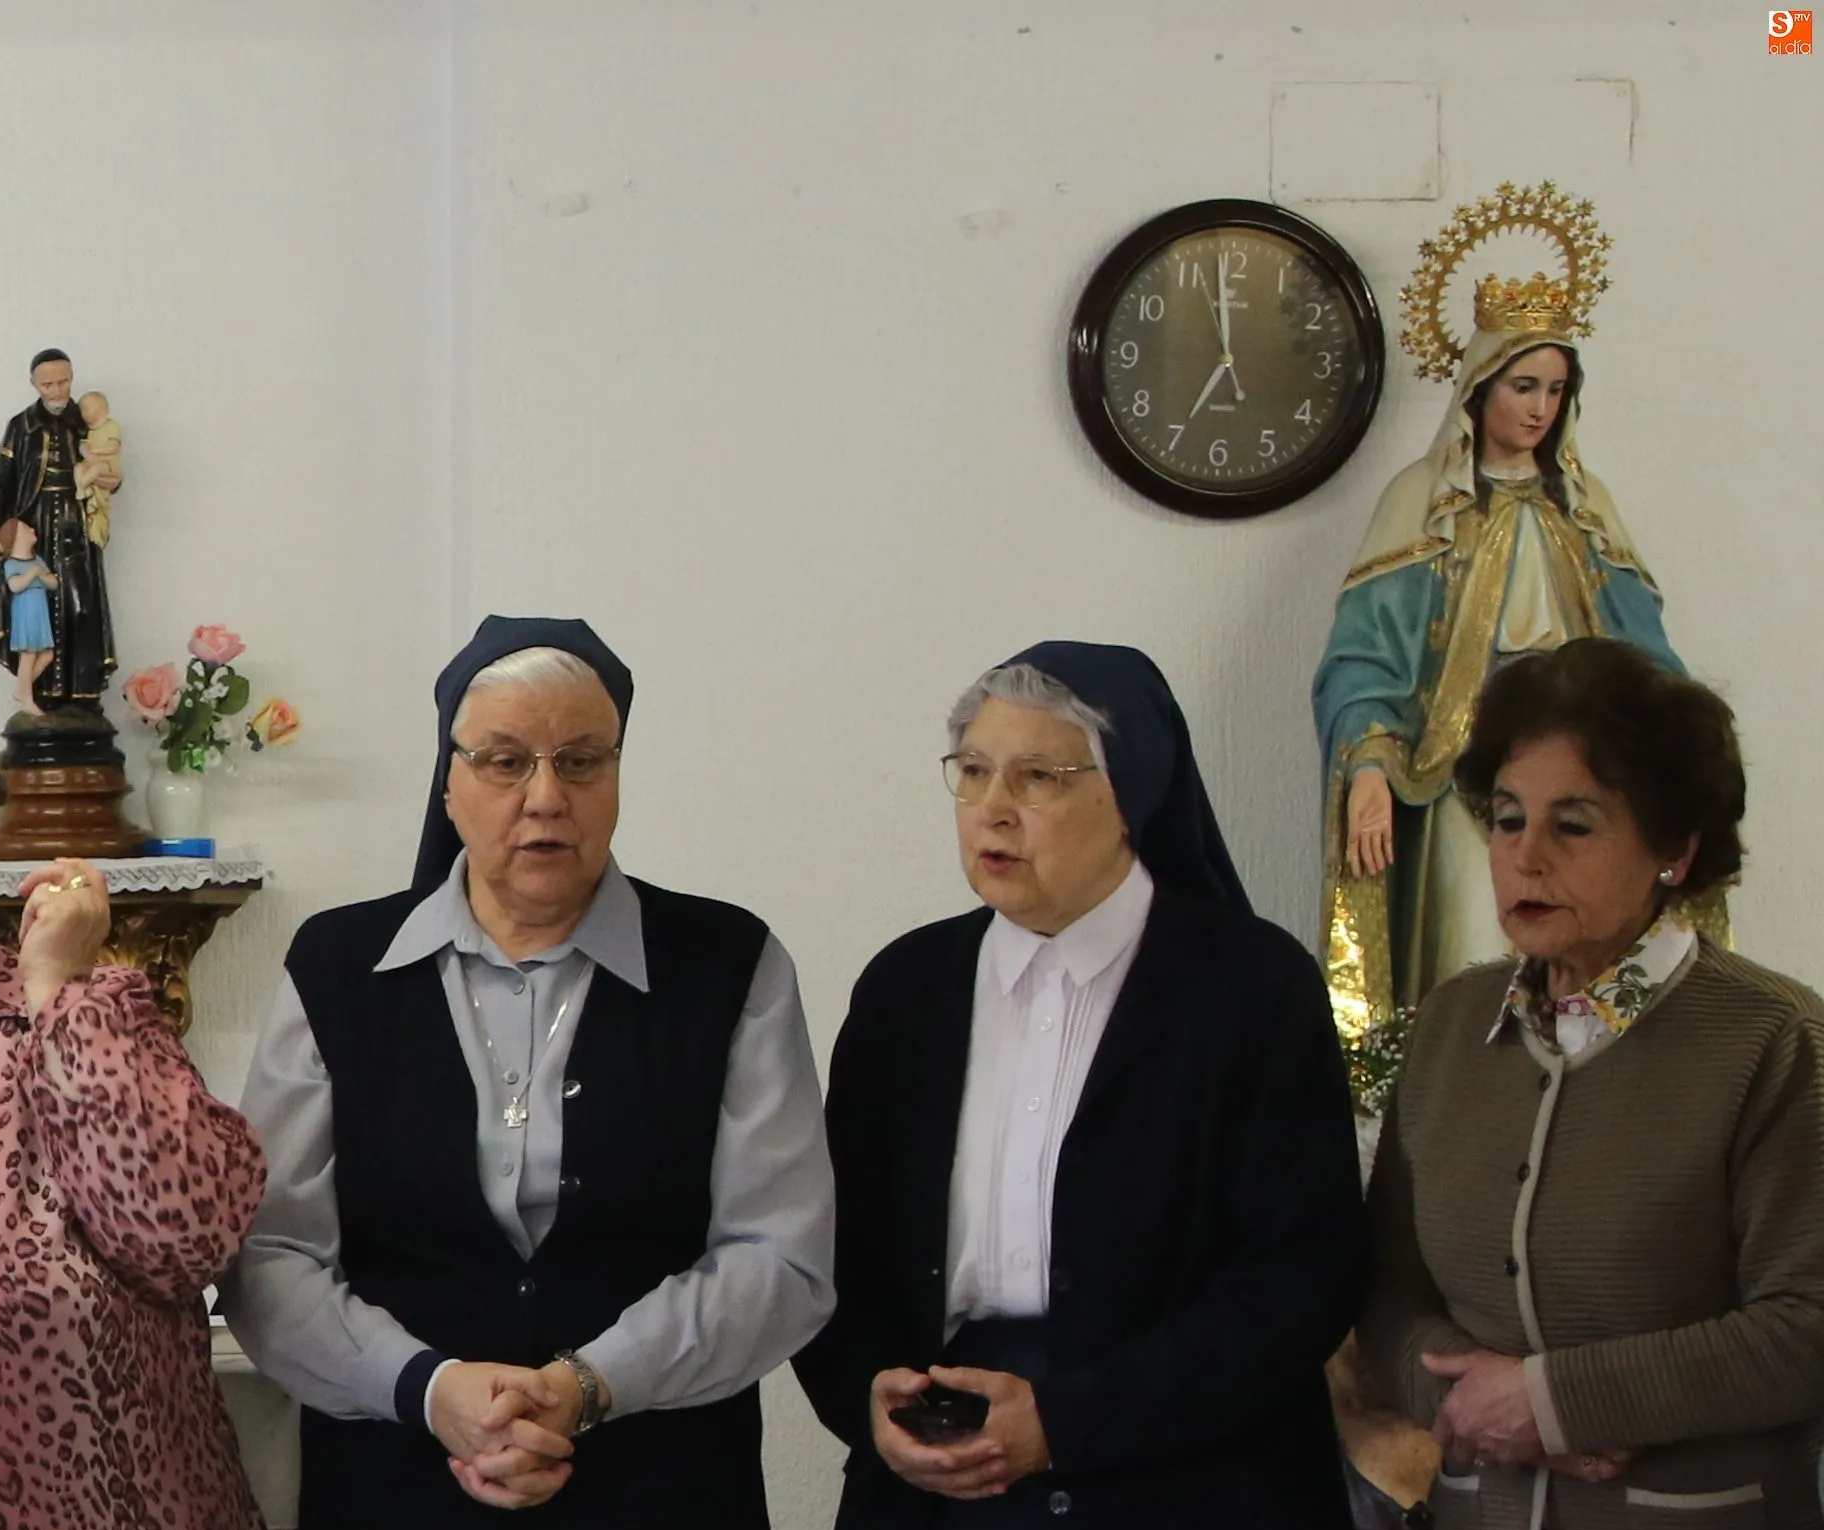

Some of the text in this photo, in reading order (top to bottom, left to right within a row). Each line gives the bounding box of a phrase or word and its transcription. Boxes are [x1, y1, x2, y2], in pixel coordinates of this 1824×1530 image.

[1179, 261, 1199, 289] 11
[1278, 267, 1284, 294] 1
[1139, 295, 1164, 322] 10
[1305, 303, 1322, 330] 2
[1120, 341, 1139, 369] 9
[1313, 352, 1331, 379] 3
[1132, 390, 1150, 417] 8
[1294, 399, 1312, 426] 4
[1168, 425, 1186, 451] 7
[1258, 430, 1275, 457] 5
[1209, 439, 1228, 466] 6
